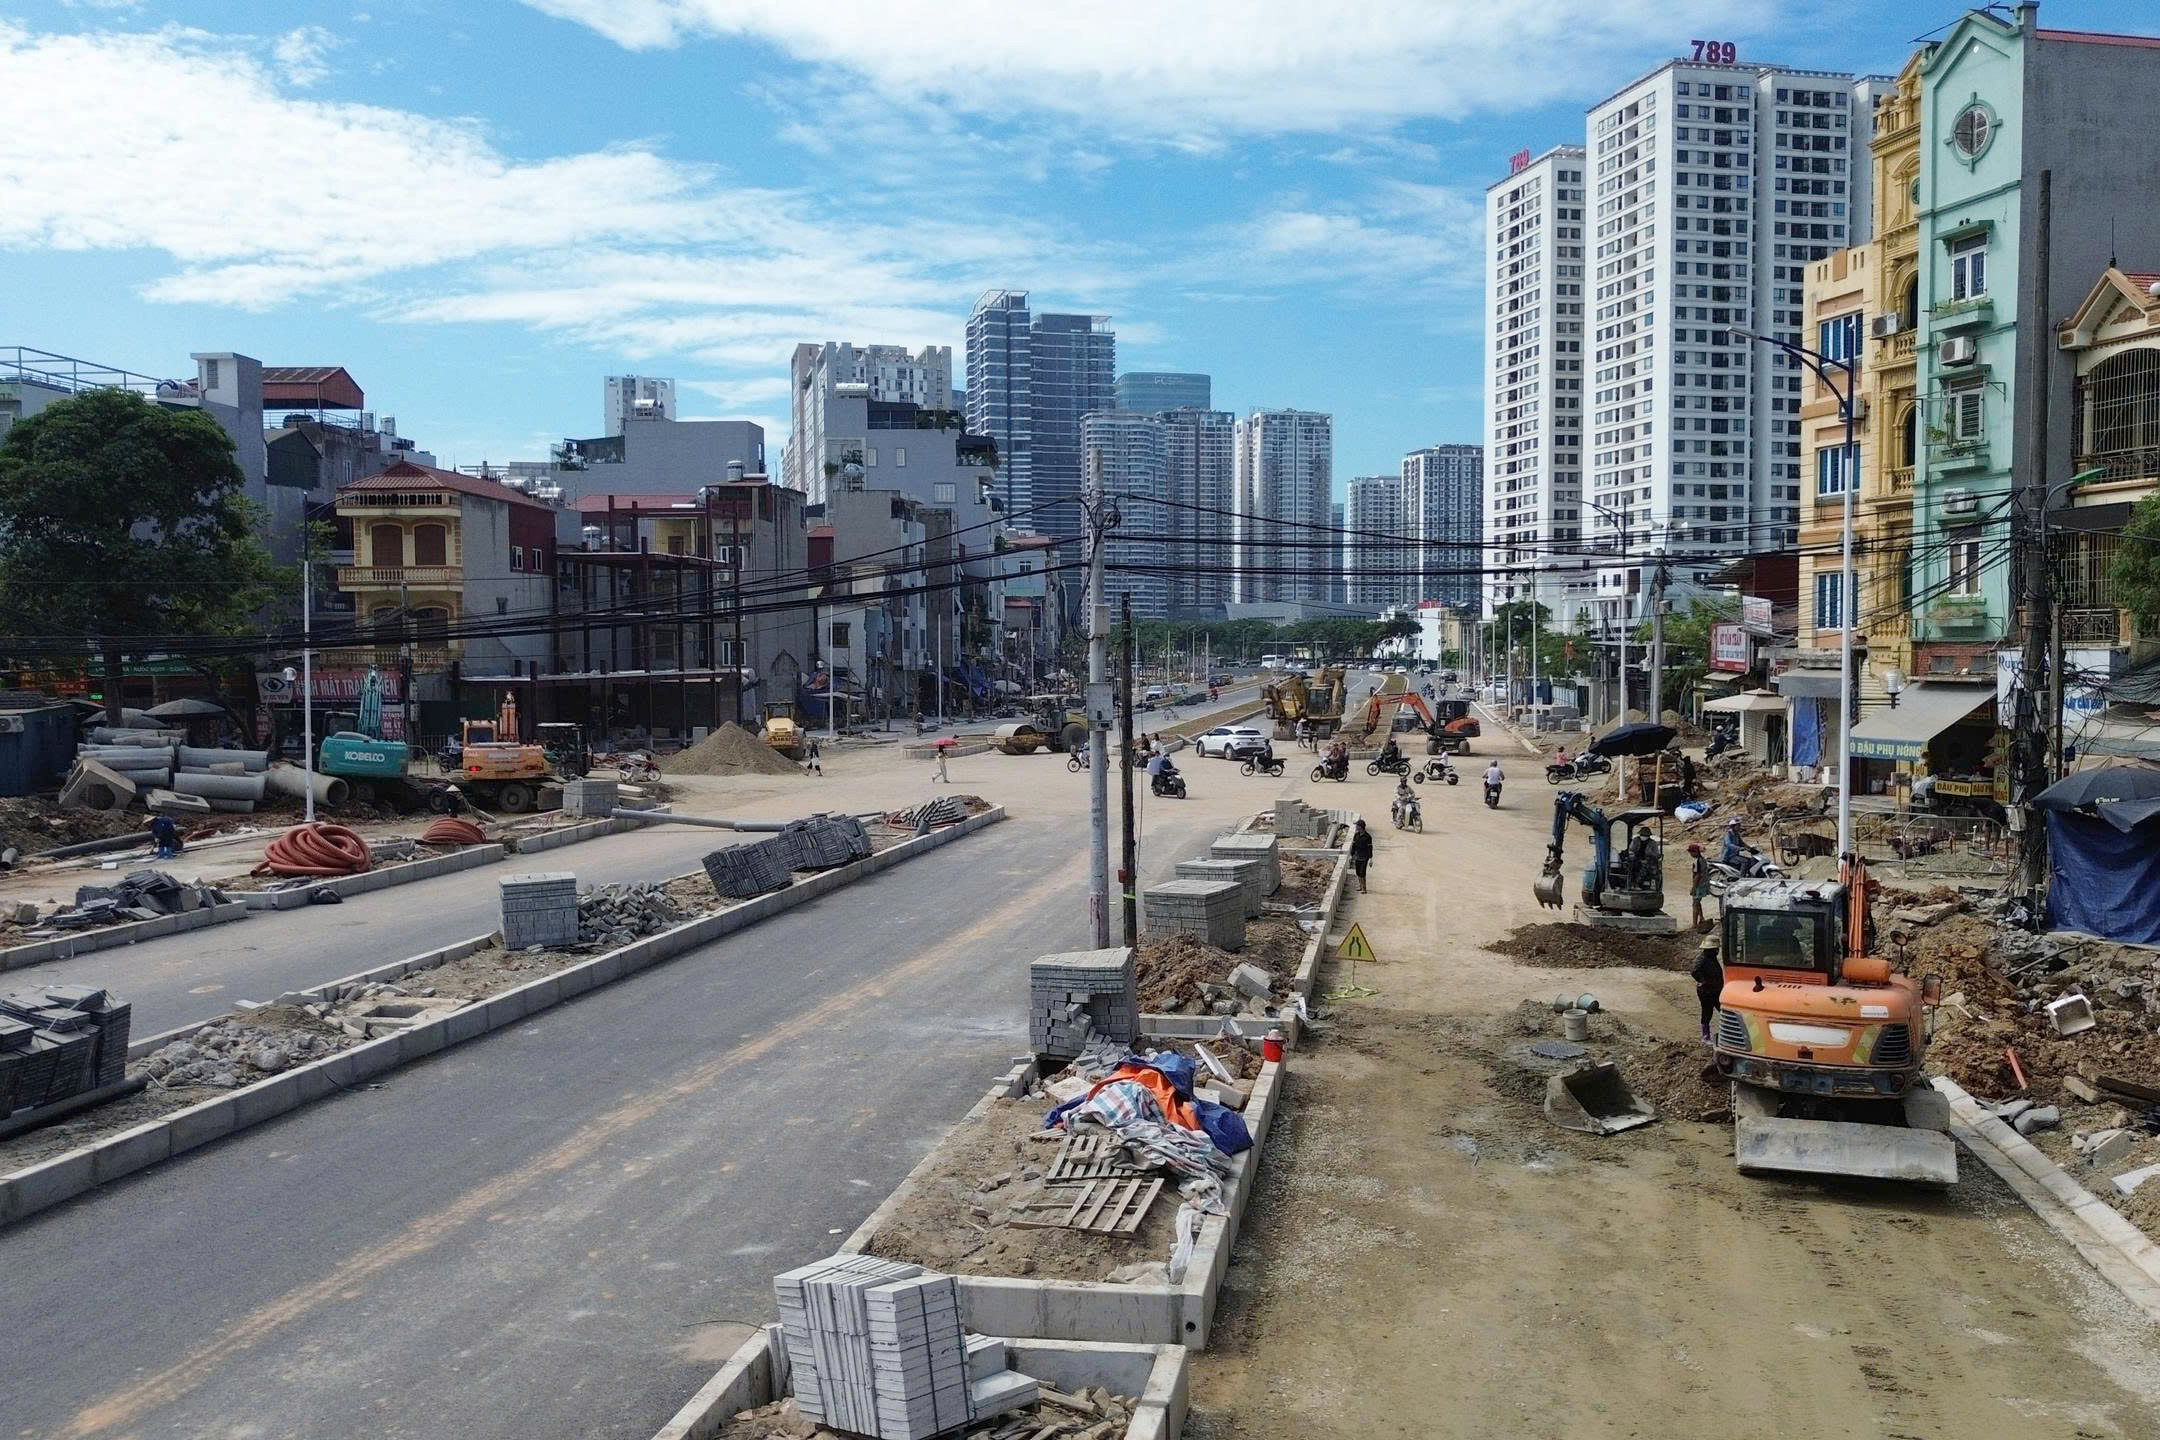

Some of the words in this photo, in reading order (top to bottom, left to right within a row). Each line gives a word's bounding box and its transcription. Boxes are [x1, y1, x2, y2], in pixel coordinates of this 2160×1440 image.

[1691, 40, 1736, 64] 789
[1508, 149, 1530, 174] 789
[344, 751, 386, 763] KOBELCO
[1857, 741, 1875, 757] ĐẬU
[1876, 744, 1895, 758] PHỤ
[1896, 742, 1922, 757] NÓNG
[1953, 784, 1969, 794] PHỤ
